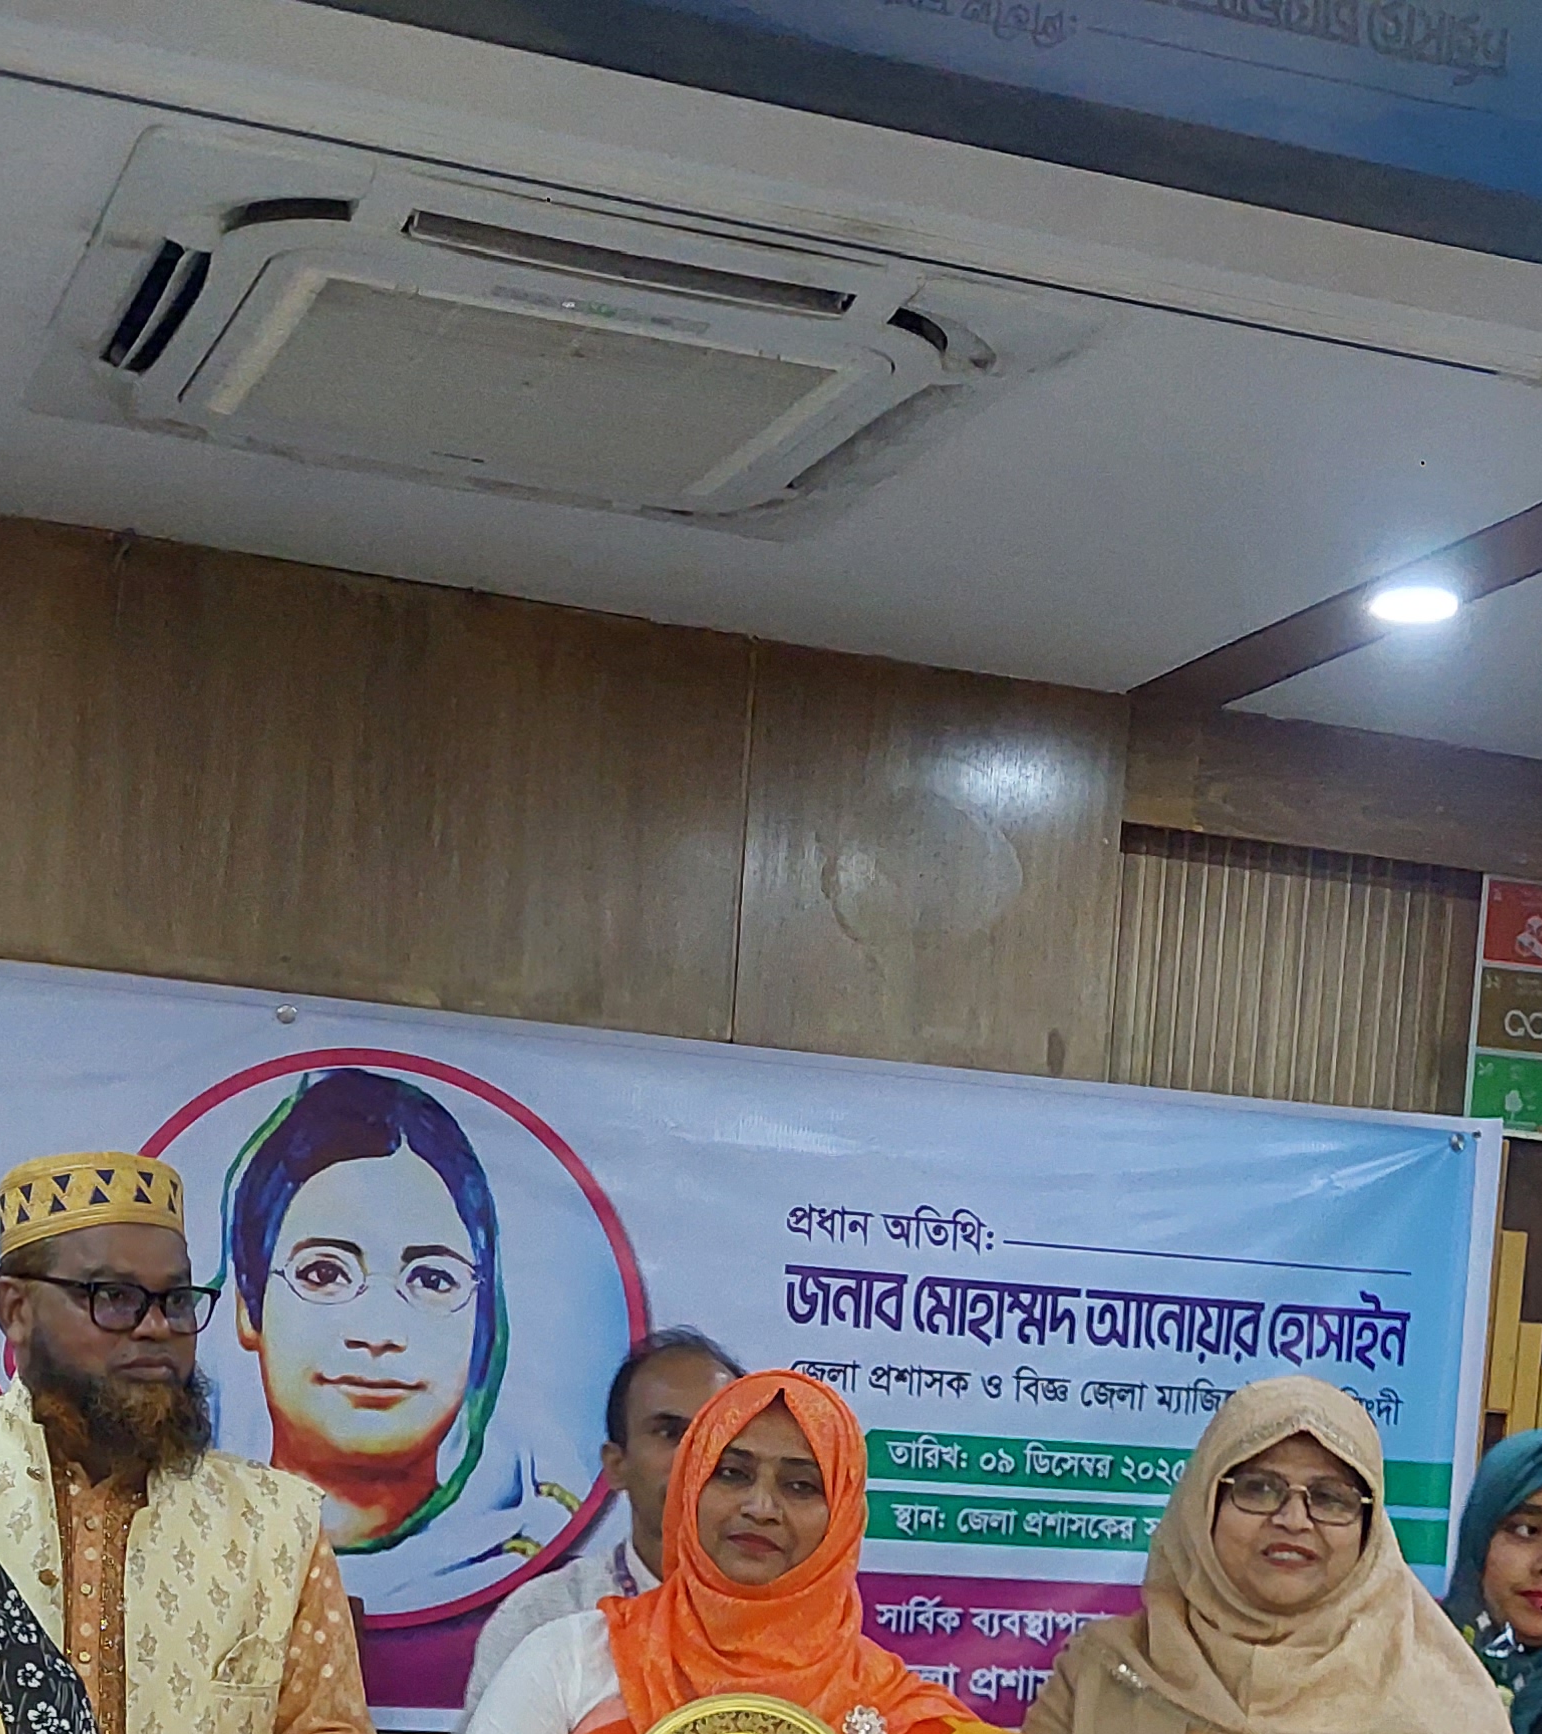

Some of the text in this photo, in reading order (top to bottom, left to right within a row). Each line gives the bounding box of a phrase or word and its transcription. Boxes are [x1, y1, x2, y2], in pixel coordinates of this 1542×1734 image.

[786, 1203, 996, 1255] প্রধান অতিথি:
[784, 1263, 1411, 1368] জনাব মোহাম্মদ আনোয়ার হোসাইন
[869, 1363, 970, 1397] প্রশাসক
[981, 1375, 1002, 1400] ও
[1013, 1366, 1069, 1403] বিজ্ঞ
[1079, 1381, 1148, 1411] জেলা
[887, 1433, 968, 1472] তারিখ:
[978, 1449, 1016, 1476] ০৯
[1022, 1441, 1112, 1480] ডিসেম্বর
[890, 1501, 947, 1534] স্থান:
[957, 1507, 1016, 1538] জেলা
[1022, 1509, 1138, 1543] প্রশাসকের
[875, 1598, 961, 1636] সার্বিক
